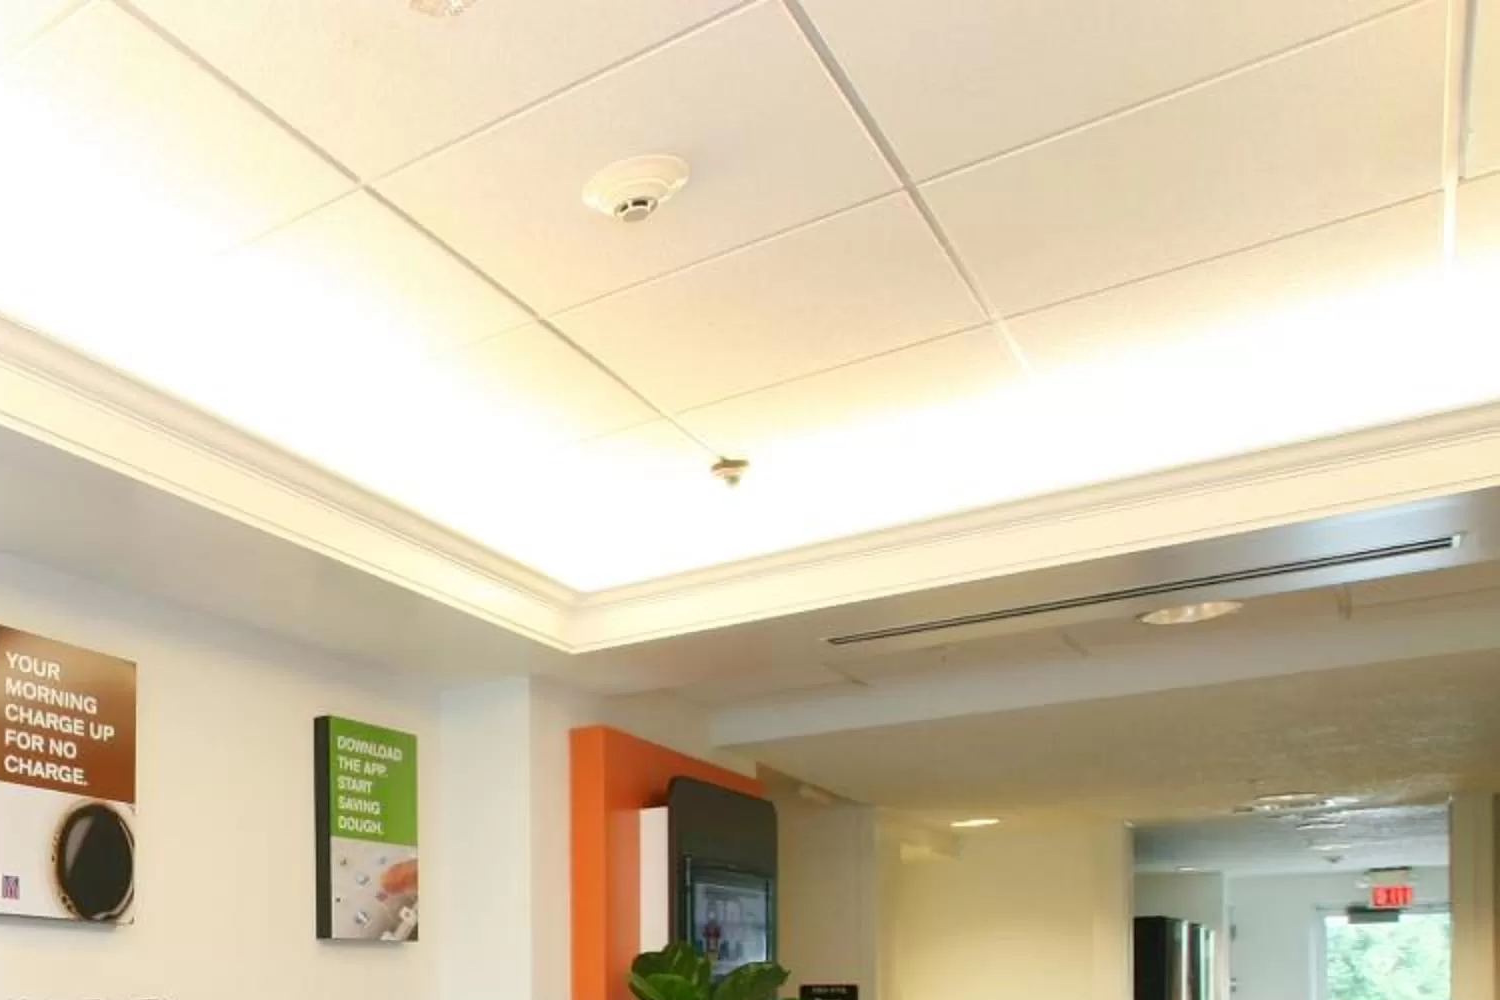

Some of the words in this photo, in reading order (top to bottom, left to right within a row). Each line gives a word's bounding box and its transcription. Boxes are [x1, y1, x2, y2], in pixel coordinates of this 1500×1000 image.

[5, 651, 61, 681] YOUR
[5, 677, 98, 715] MORNING
[4, 703, 85, 737] CHARGE
[89, 723, 115, 743] UP
[4, 729, 44, 753] FOR
[49, 738, 77, 760] NO
[337, 736, 403, 761] DOWNLOAD
[3, 754, 90, 787] CHARGE.
[337, 755, 361, 774] THE
[337, 775, 373, 794] START
[338, 795, 381, 815] SAVING
